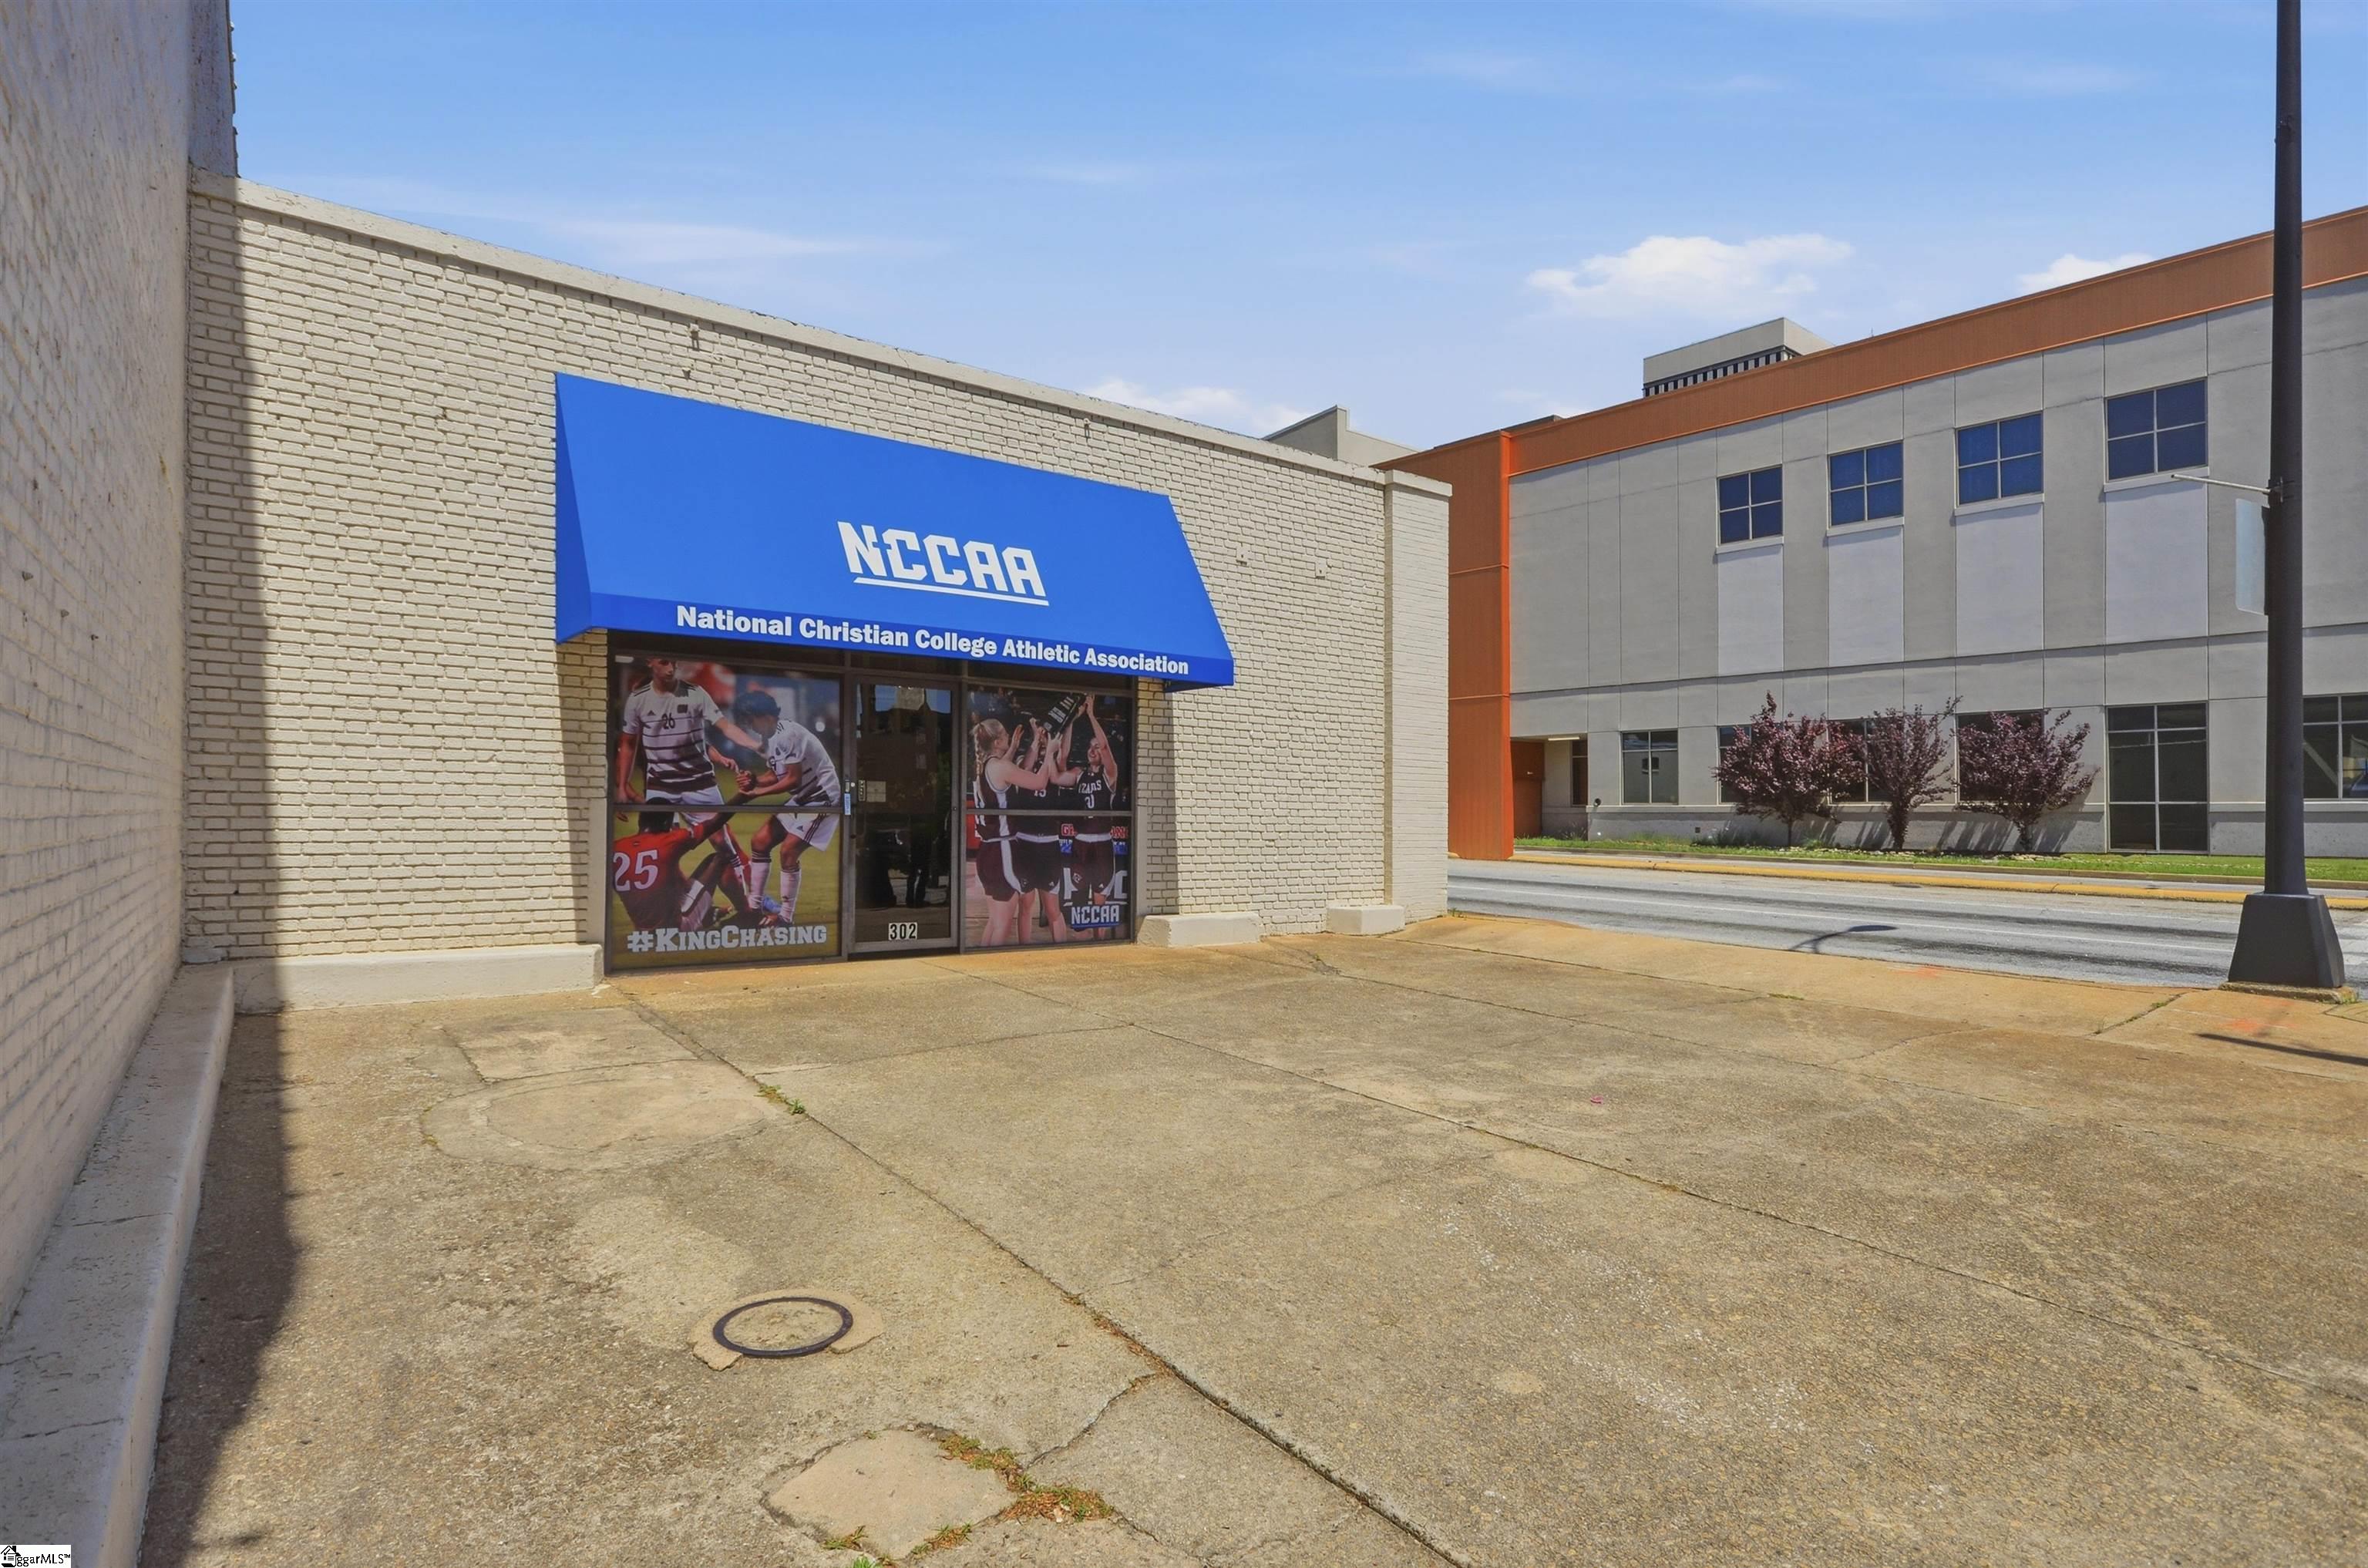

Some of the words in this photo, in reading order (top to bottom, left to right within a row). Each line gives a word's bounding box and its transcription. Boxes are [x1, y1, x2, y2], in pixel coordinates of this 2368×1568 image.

[838, 521, 1046, 597] NCCAA
[677, 605, 792, 636] National
[799, 617, 909, 647] Christian
[916, 629, 997, 657] College
[1002, 638, 1080, 664] Athletic
[1084, 648, 1189, 675] Association
[613, 850, 658, 892] 25
[890, 924, 917, 940] 302
[1071, 904, 1119, 925] NCCAA
